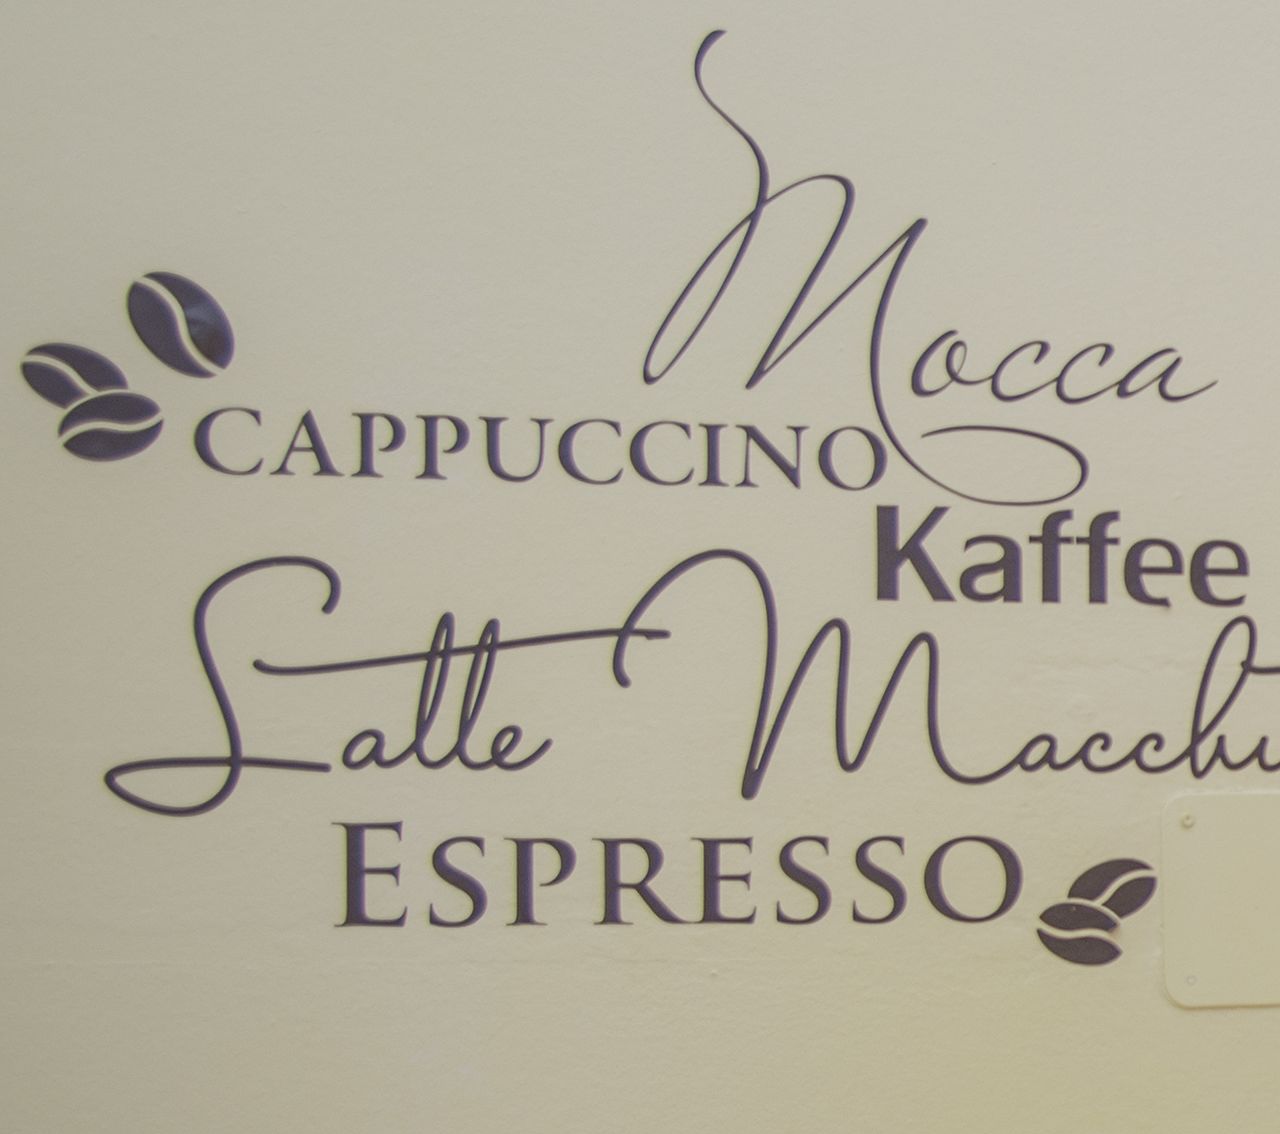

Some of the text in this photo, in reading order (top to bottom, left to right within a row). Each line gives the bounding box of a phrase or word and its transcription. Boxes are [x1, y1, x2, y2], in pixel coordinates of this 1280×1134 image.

[643, 29, 1218, 506] Mocca
[193, 407, 888, 497] CAPPUCCINO
[875, 504, 1250, 609] Kaffee
[103, 555, 668, 818] Latte
[331, 820, 1023, 929] ESPRESSO
